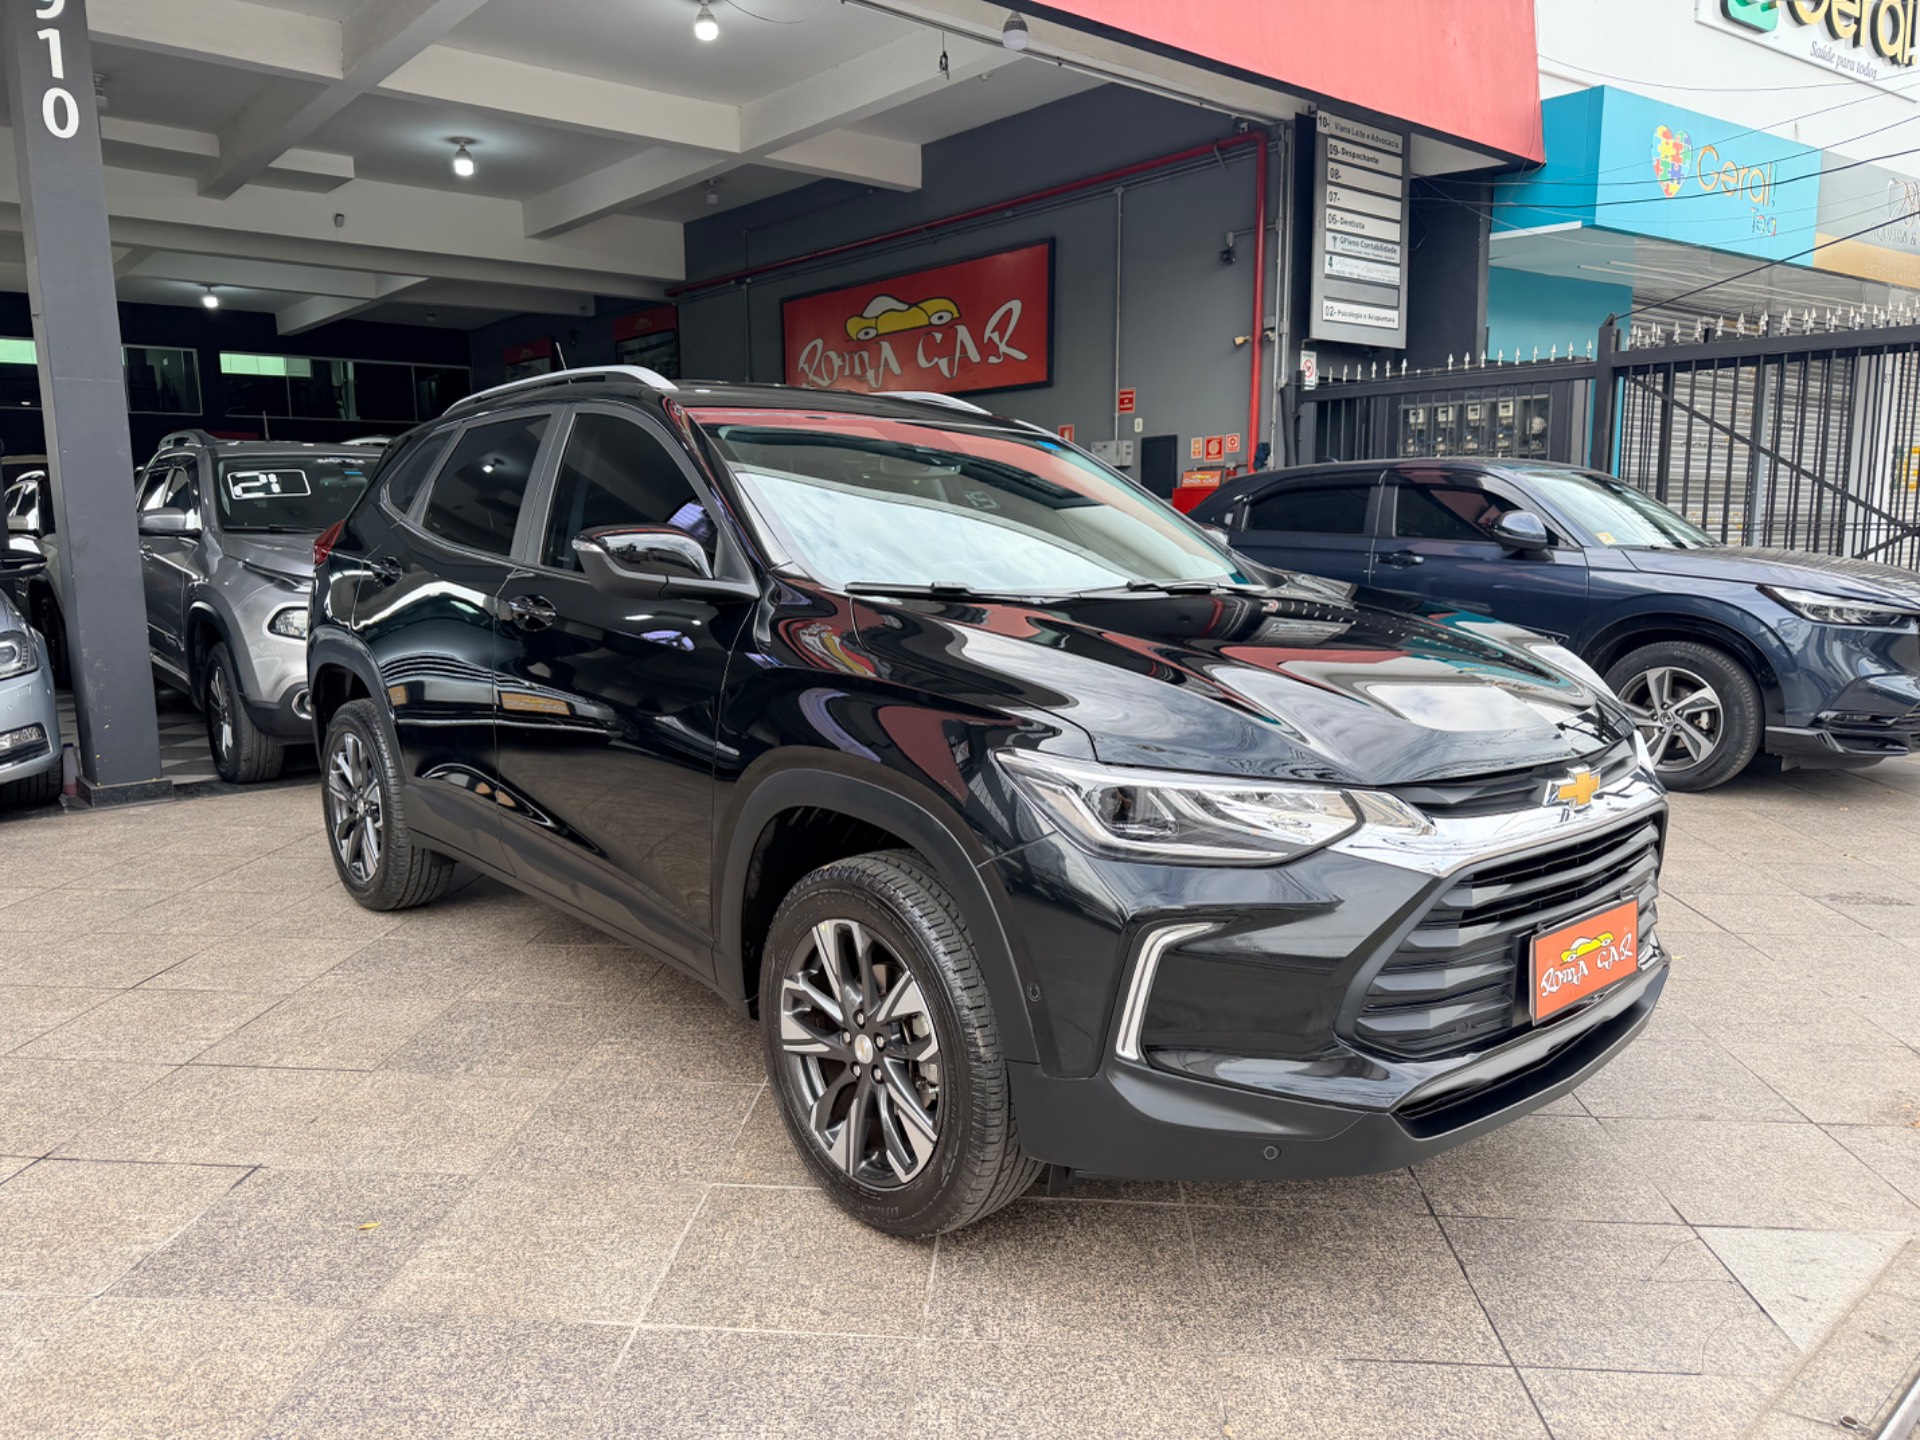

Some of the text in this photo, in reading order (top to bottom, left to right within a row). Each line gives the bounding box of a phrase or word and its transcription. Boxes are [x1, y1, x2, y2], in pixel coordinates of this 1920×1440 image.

[1810, 40, 1878, 80] Saúde para todos
[1370, 133, 1399, 149] Advocacia
[1341, 147, 1379, 165] Despachante
[1340, 217, 1365, 230] Dentista
[1360, 240, 1398, 255] Contabilidade
[1337, 309, 1363, 321] Psicologia
[917, 299, 1028, 379] CAR
[233, 472, 281, 497] 21
[1596, 932, 1634, 970] CAR
